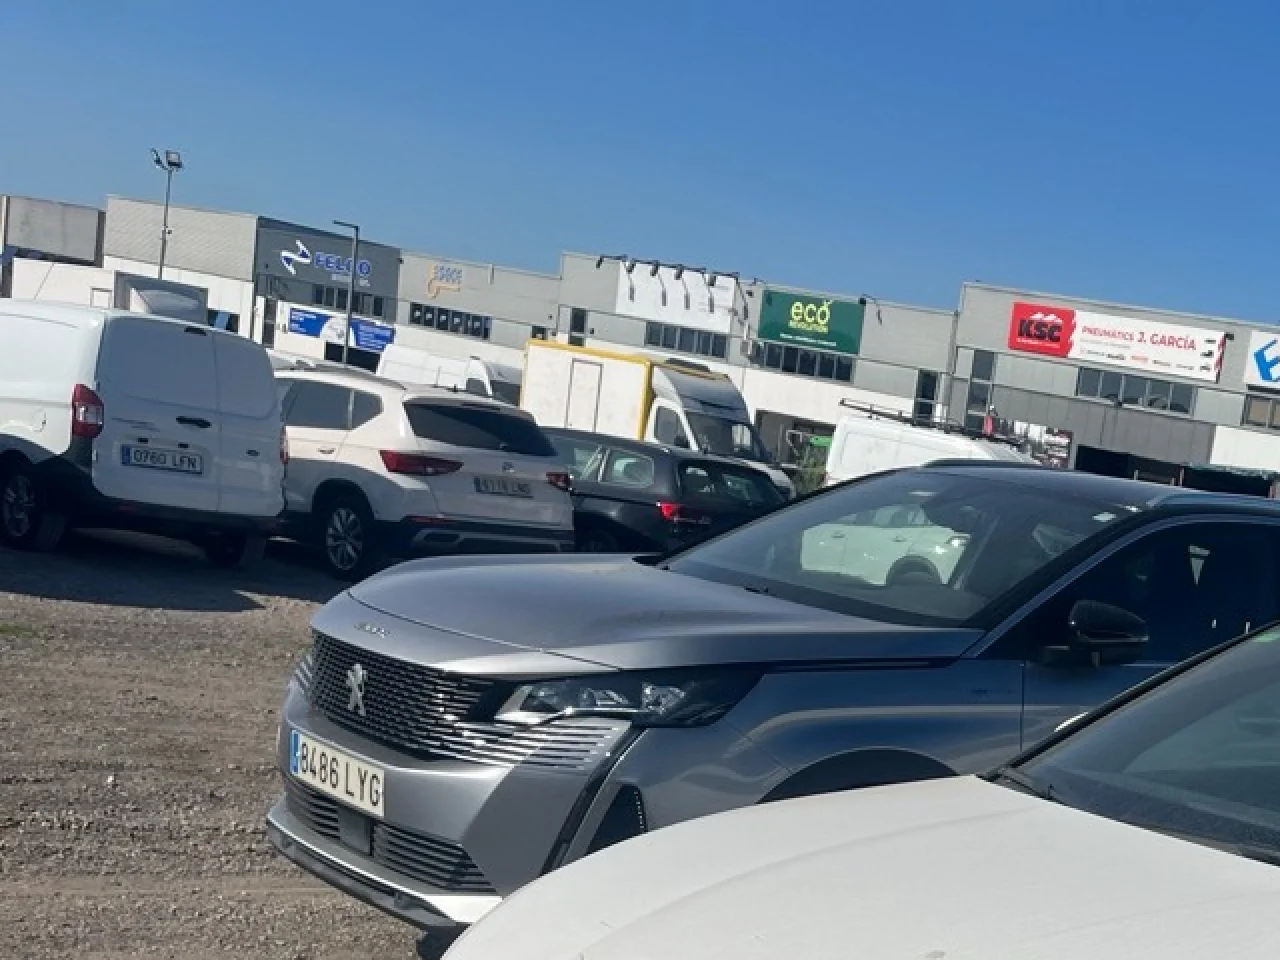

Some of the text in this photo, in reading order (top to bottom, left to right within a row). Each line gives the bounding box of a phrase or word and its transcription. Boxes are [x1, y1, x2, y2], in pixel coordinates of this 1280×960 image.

[1018, 319, 1063, 342] KSC
[1137, 332, 1146, 343] J.
[1149, 333, 1197, 351] GARCÍA
[301, 742, 382, 807] 8486 LYG
